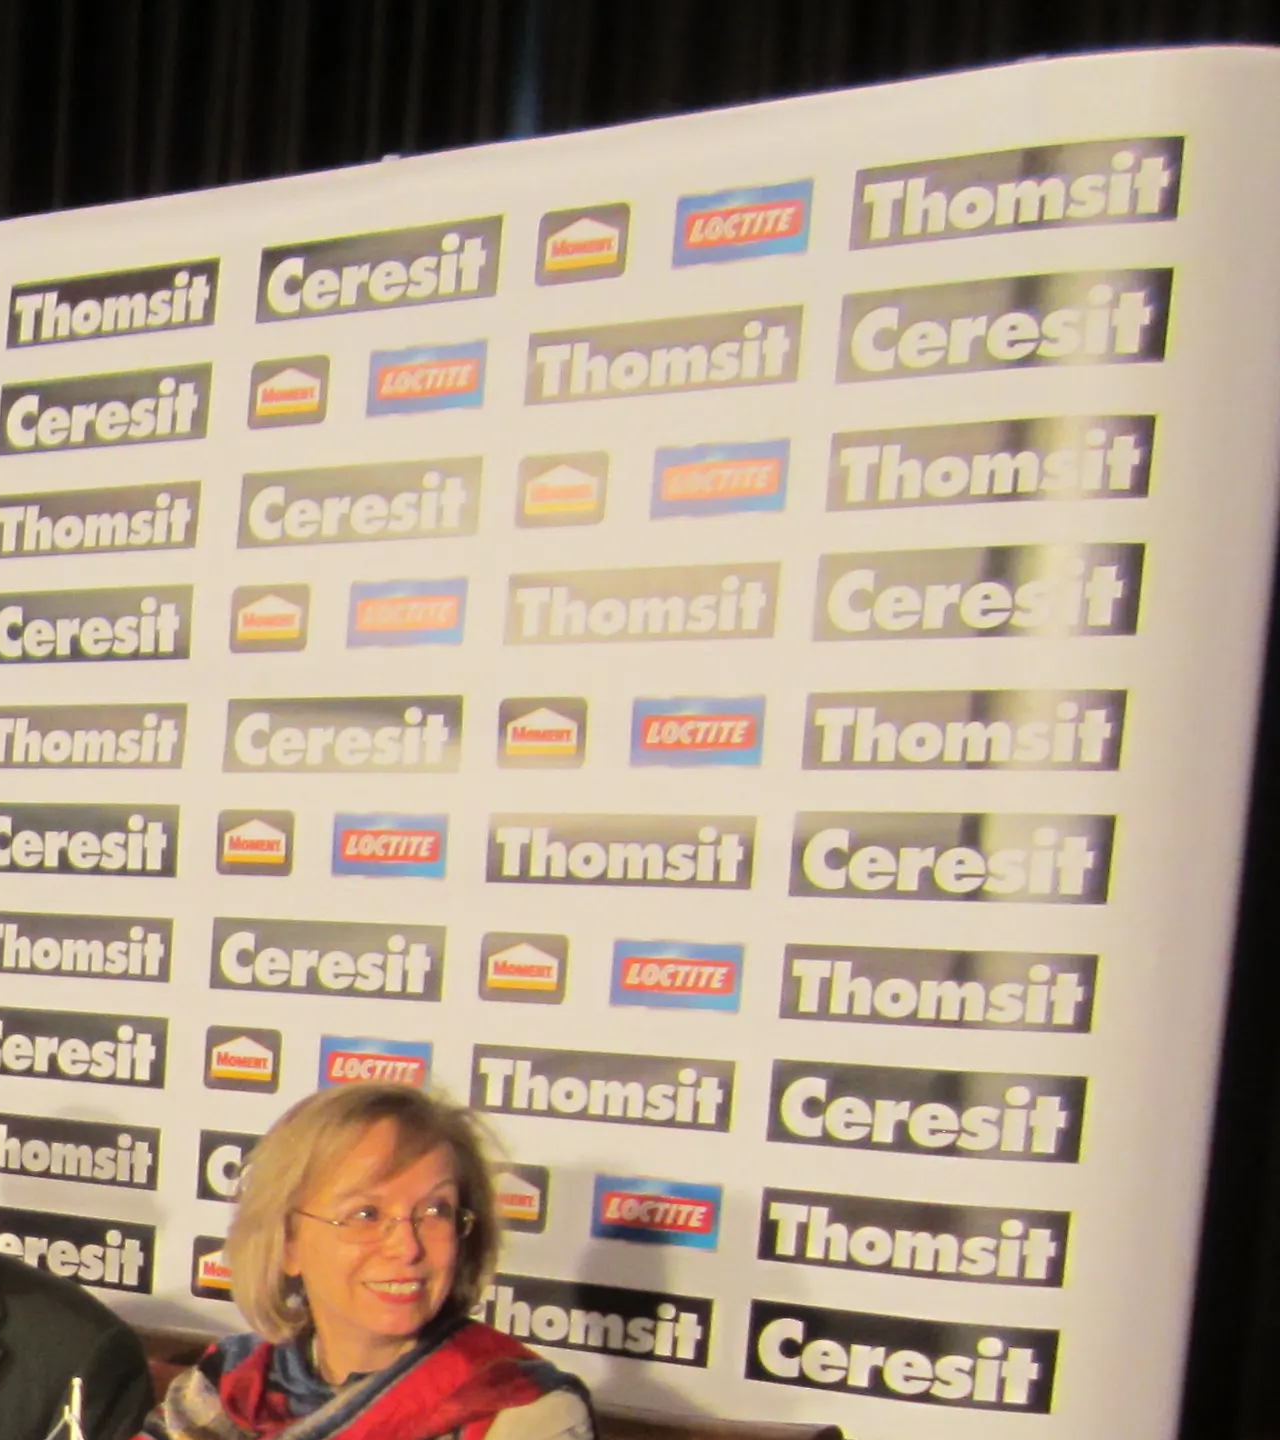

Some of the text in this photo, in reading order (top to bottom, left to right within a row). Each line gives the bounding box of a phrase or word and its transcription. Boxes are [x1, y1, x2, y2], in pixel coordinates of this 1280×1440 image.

[862, 151, 1171, 240] Thomsit
[14, 271, 211, 344] Thomsit
[265, 232, 488, 314] Ceresit
[536, 321, 789, 398] Thomsit
[850, 286, 1151, 372] Ceresit
[6, 376, 199, 449] Ceresit
[840, 430, 1139, 502] Thomsit
[248, 471, 468, 539] Ceresit
[515, 576, 766, 635] Thomsit
[828, 558, 1125, 630] Ceresit
[234, 706, 449, 766] Ceresit
[814, 704, 1109, 764] Thomsit
[496, 826, 742, 881] Thomsit
[802, 830, 1092, 895] Ceresit
[219, 931, 431, 993] Ceresit
[790, 960, 1082, 1025] Thomsit
[479, 1059, 721, 1124] Thomsit
[780, 1076, 1065, 1154] Ceresit
[769, 1204, 1055, 1280] Thomsit
[756, 1319, 1038, 1405] Ceresit
